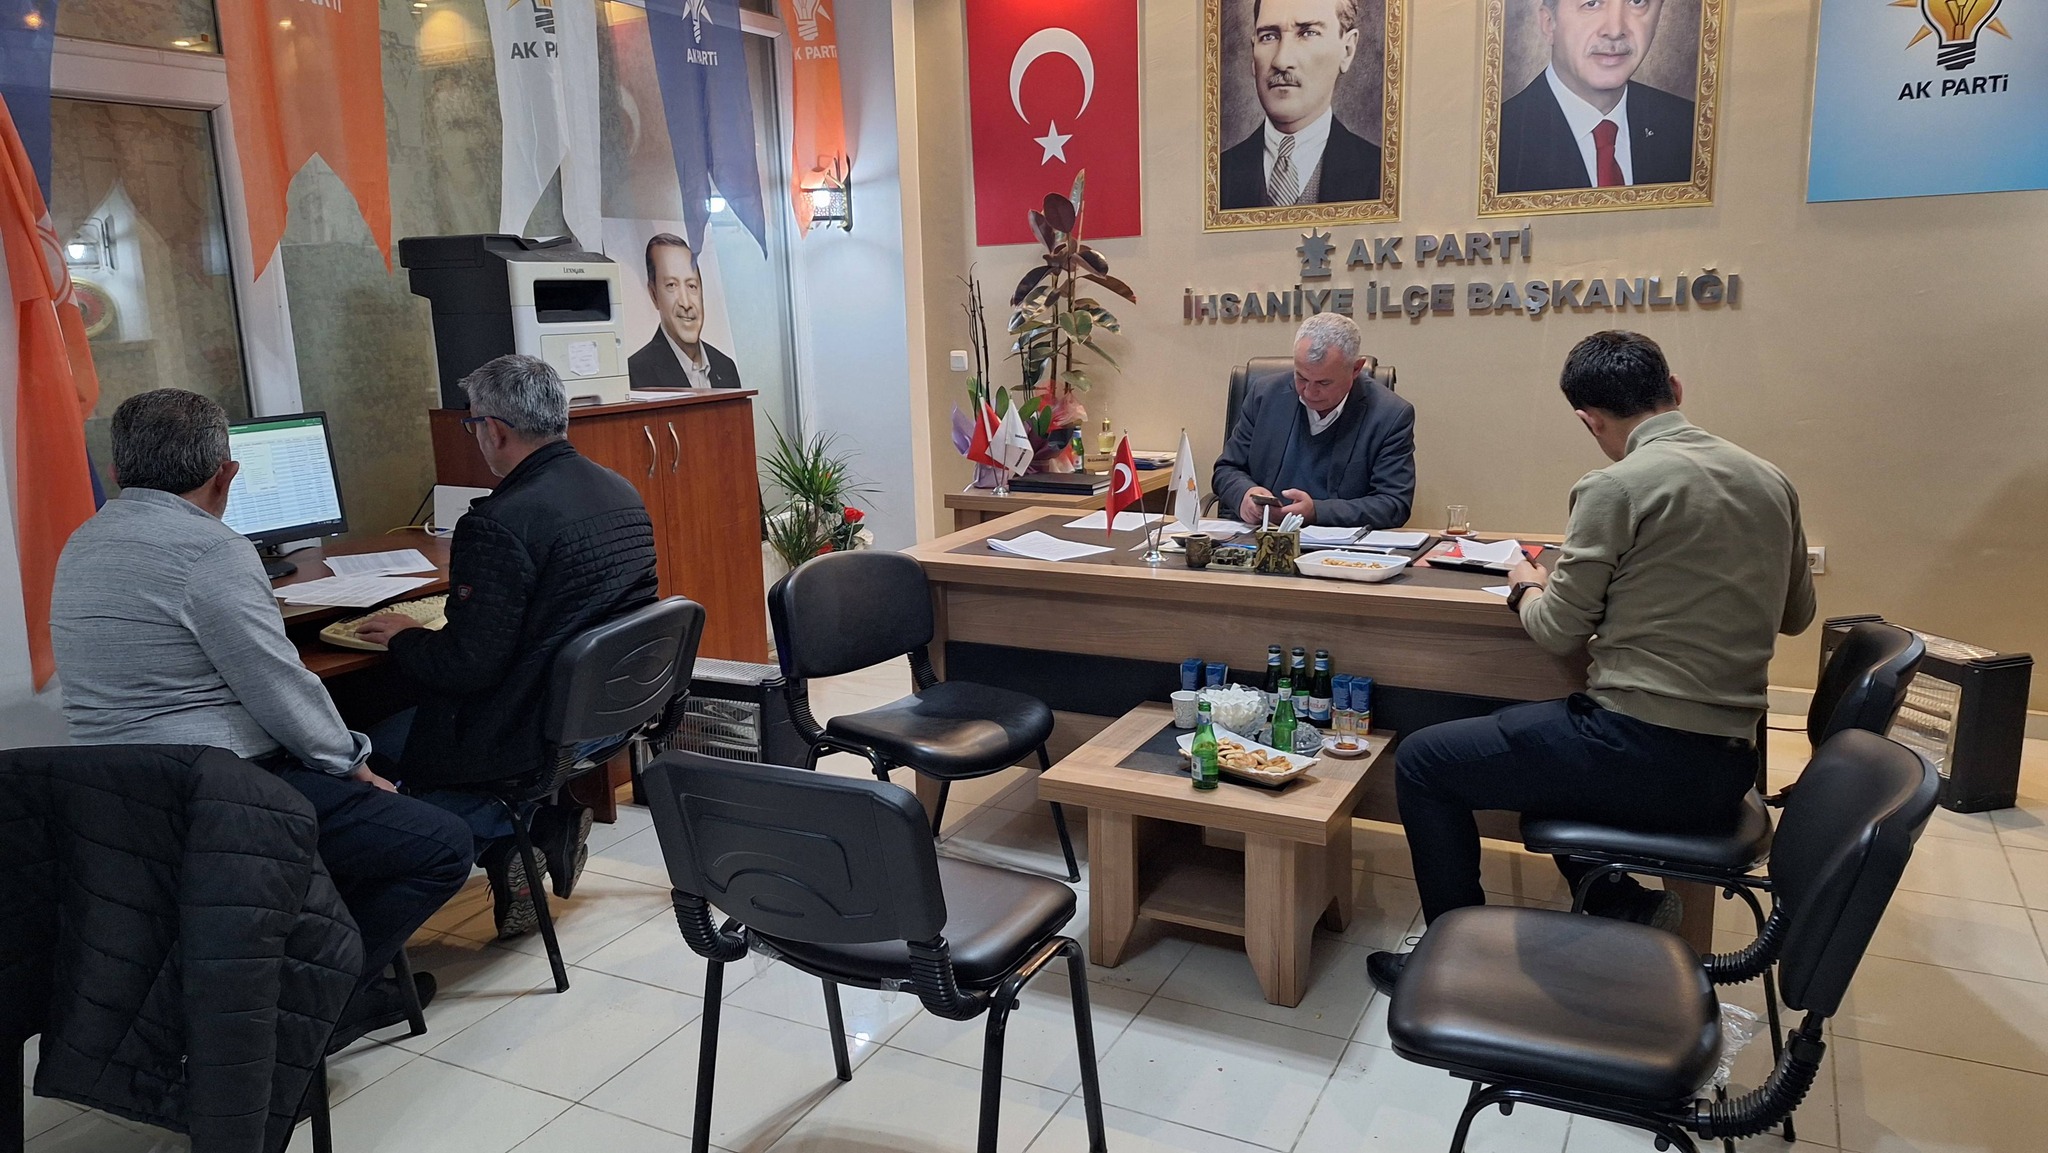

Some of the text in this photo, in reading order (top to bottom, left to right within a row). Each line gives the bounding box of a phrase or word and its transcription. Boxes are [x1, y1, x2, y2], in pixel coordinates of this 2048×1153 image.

[511, 41, 539, 59] AK
[1898, 74, 2008, 100] AK PARTi
[1346, 222, 1531, 265] AK PARTİ
[1184, 267, 1739, 319] İHSANİYE İLÇE BAŞKANLIĞI
